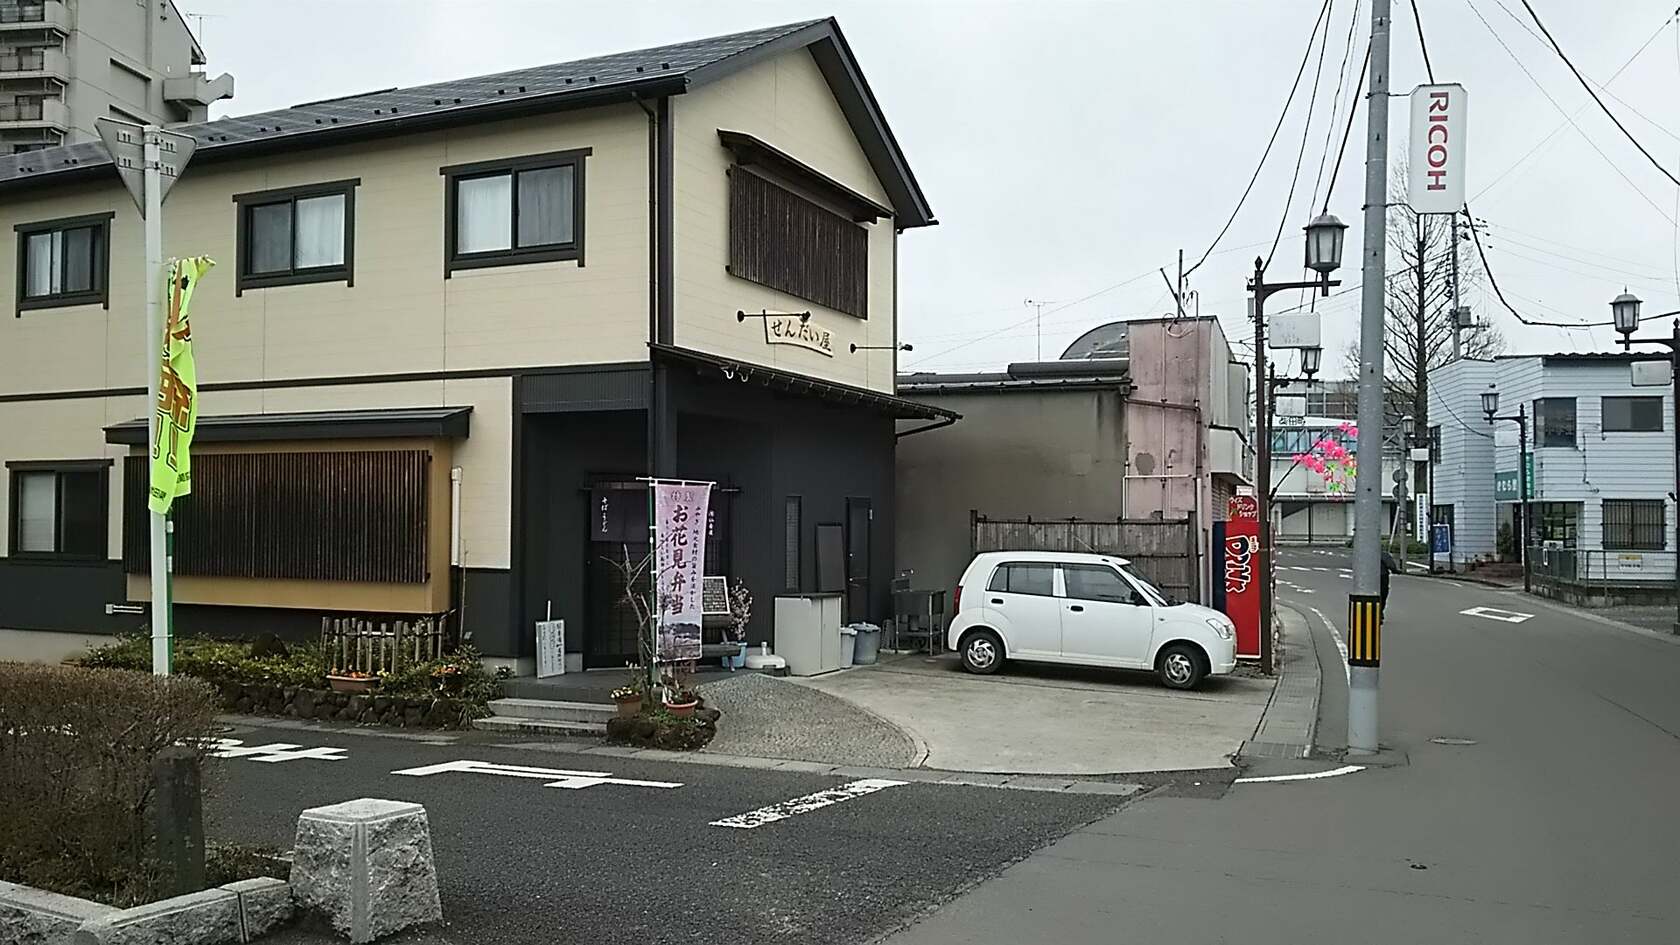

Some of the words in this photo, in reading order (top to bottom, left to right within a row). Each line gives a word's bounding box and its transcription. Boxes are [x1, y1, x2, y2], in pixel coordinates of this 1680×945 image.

[1427, 91, 1449, 191] RICOH
[771, 319, 832, 352] せんだい屋
[670, 504, 689, 616] お花見弁当
